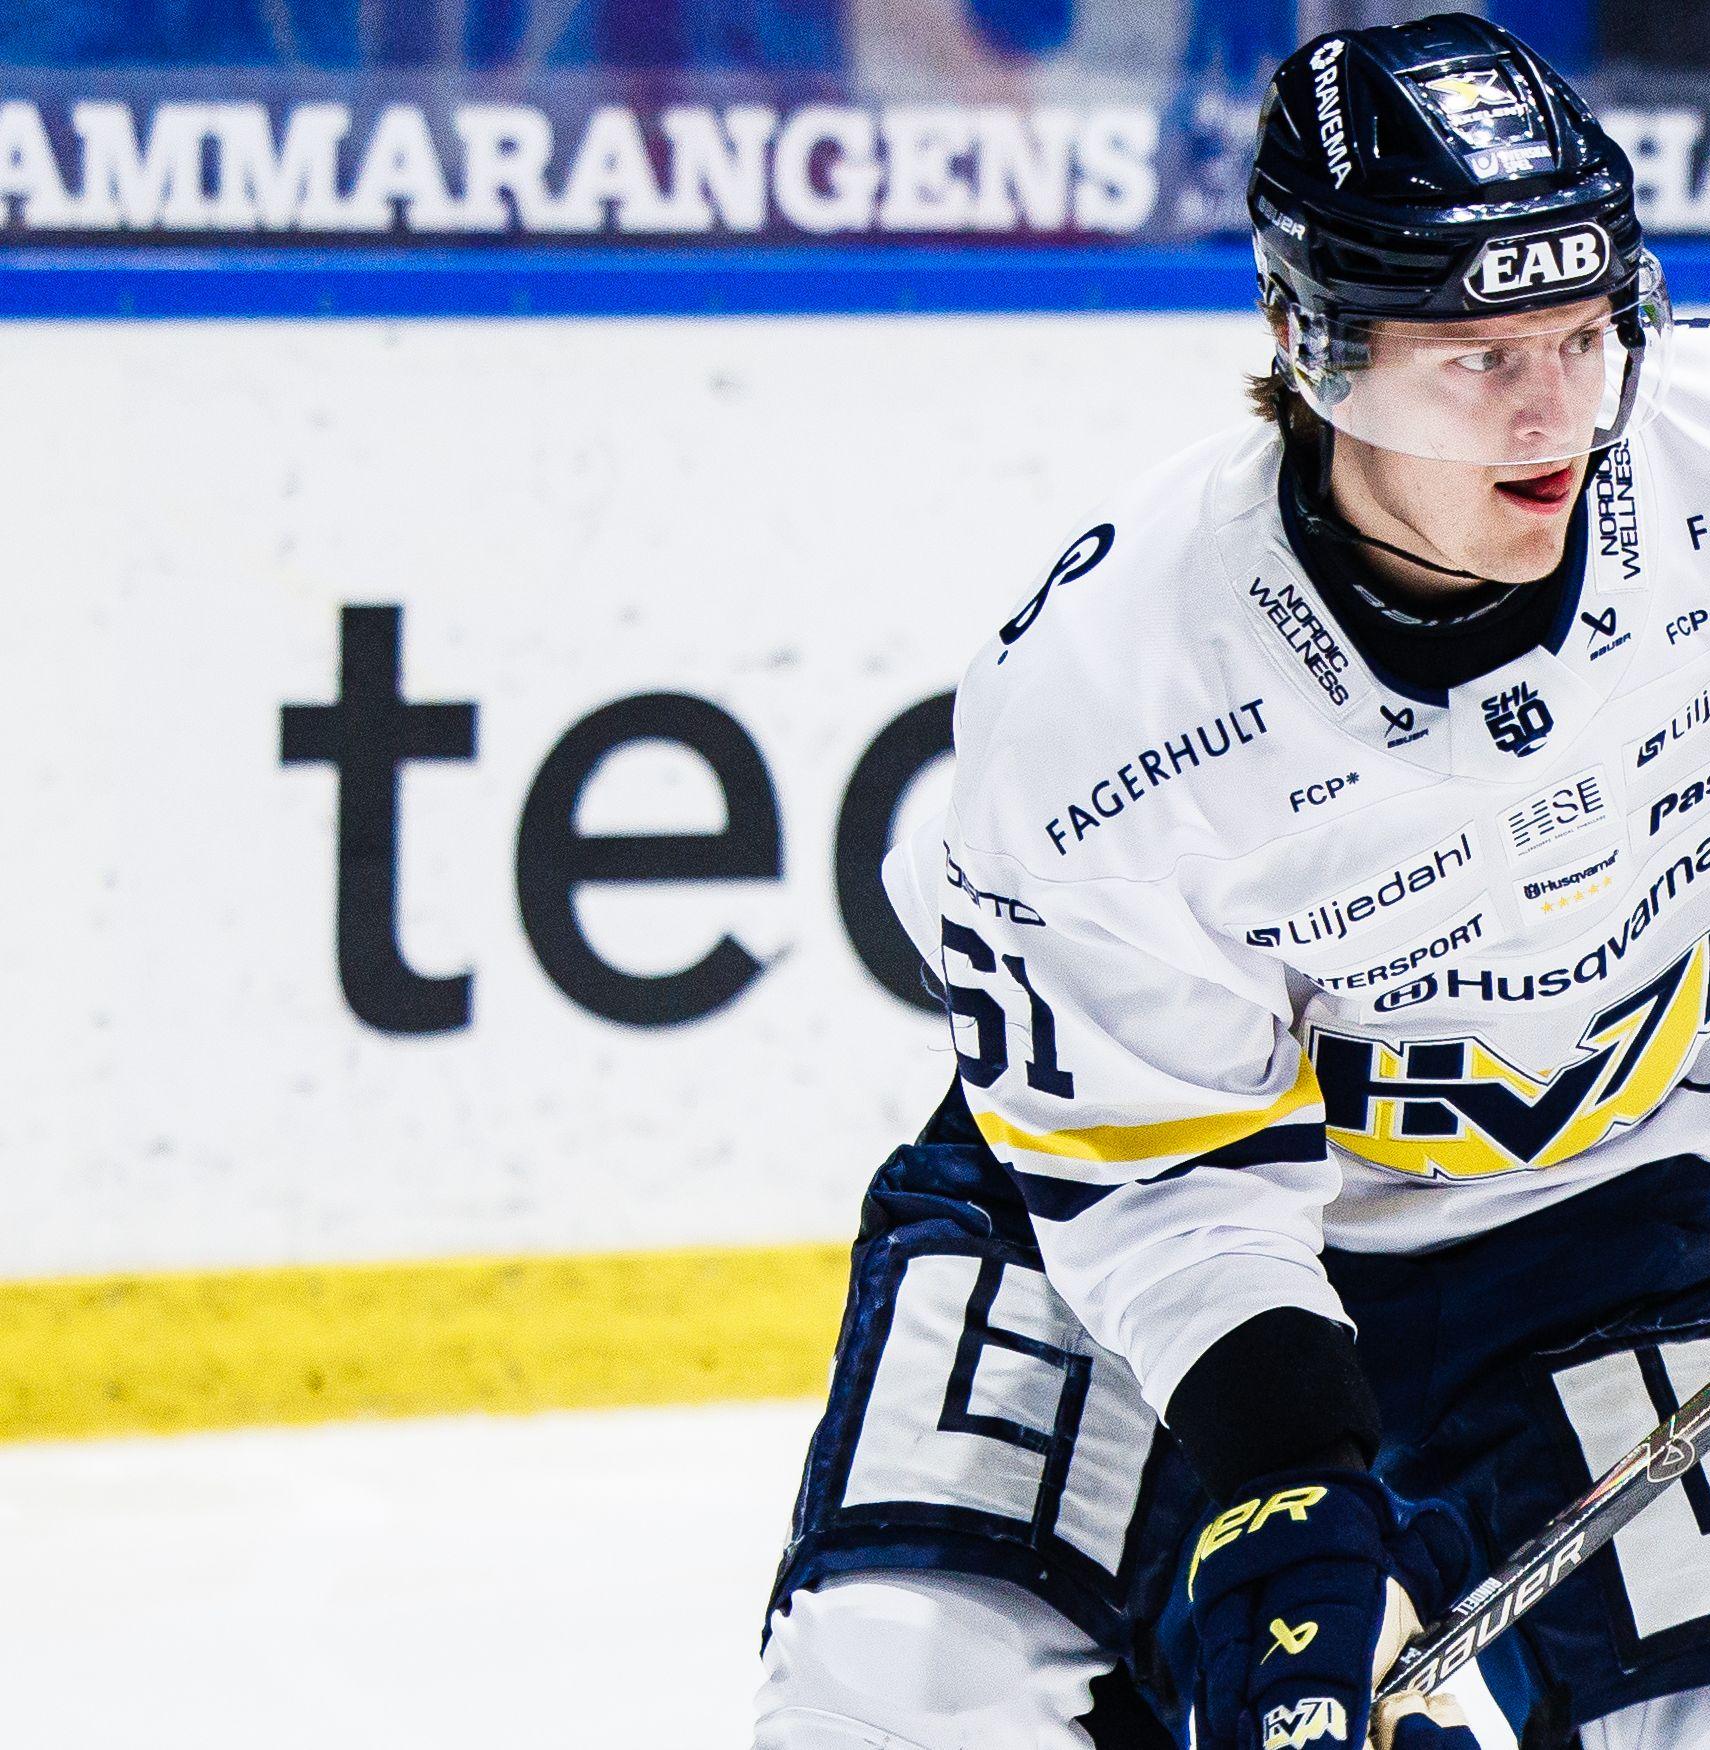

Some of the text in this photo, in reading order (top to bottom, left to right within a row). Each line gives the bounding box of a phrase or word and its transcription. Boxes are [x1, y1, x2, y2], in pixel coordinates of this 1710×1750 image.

[1314, 66, 1352, 190] RAVEMA
[1481, 231, 1601, 294] EAB
[1249, 576, 1349, 706] WELLNESS
[1277, 584, 1349, 673] NORDIC
[1481, 681, 1539, 714] SHL
[1484, 698, 1554, 757] 50
[1045, 698, 1268, 856] FAGERHULT
[1288, 833, 1472, 945] Liljedahl
[1303, 912, 1483, 990] TERSPORT
[942, 914, 1075, 1100] 61
